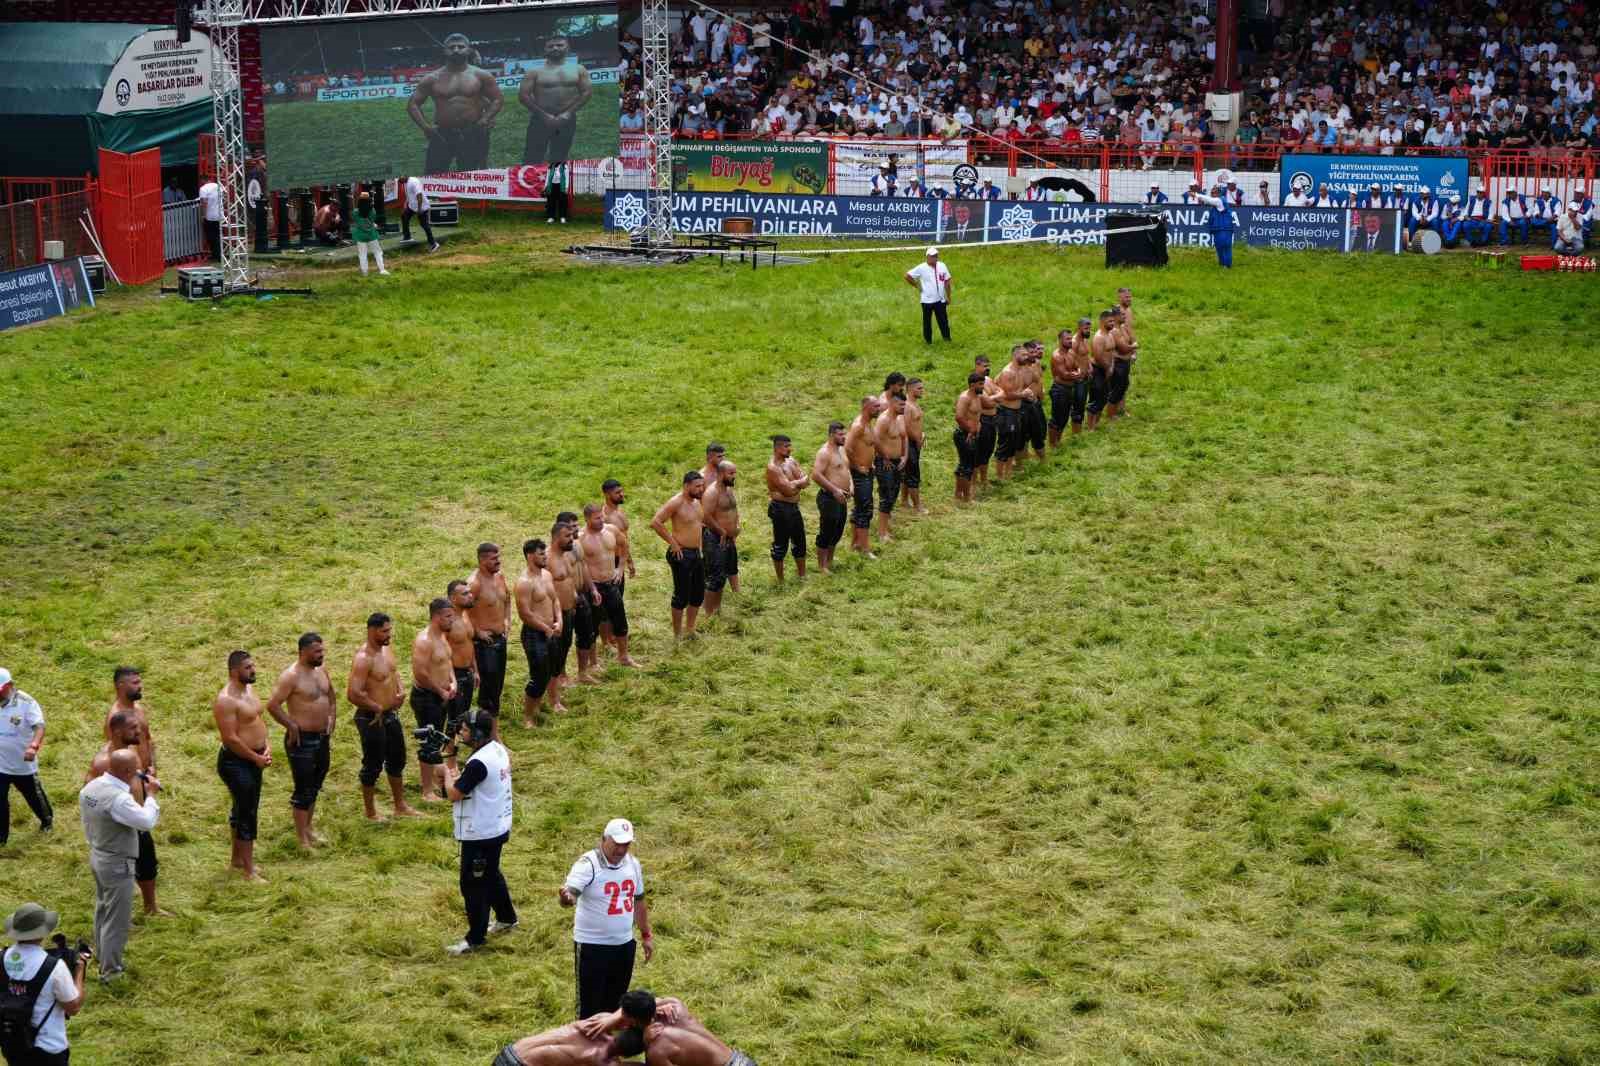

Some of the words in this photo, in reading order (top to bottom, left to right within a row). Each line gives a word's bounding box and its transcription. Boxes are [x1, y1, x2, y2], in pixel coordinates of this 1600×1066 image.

[176, 74, 203, 87] DİLERİM
[714, 144, 761, 154] DEĞİŞMEYEN
[763, 145, 779, 153] YAĞ
[780, 146, 822, 154] SPONSORU
[711, 154, 774, 187] Biryağ
[423, 183, 465, 193] FEYZULLAH
[467, 184, 498, 195] AKTÜRK
[702, 194, 838, 216] PEHLİVANLARA
[849, 202, 884, 212] Mesut
[887, 202, 932, 214] AKBIYIK
[1048, 203, 1090, 224] TÜM
[1252, 211, 1289, 222] Mesut
[1293, 212, 1339, 224] AKBIYIK
[761, 216, 832, 235] DİLERİM
[846, 215, 880, 225] Karesi
[883, 216, 932, 230] Belediye
[1249, 225, 1285, 237] Karesi
[1288, 226, 1340, 240] Belediye
[0, 279, 19, 291] esut
[19, 271, 48, 287] AKBIYIK
[21, 288, 54, 305] Belediye
[604, 879, 636, 916] 23
